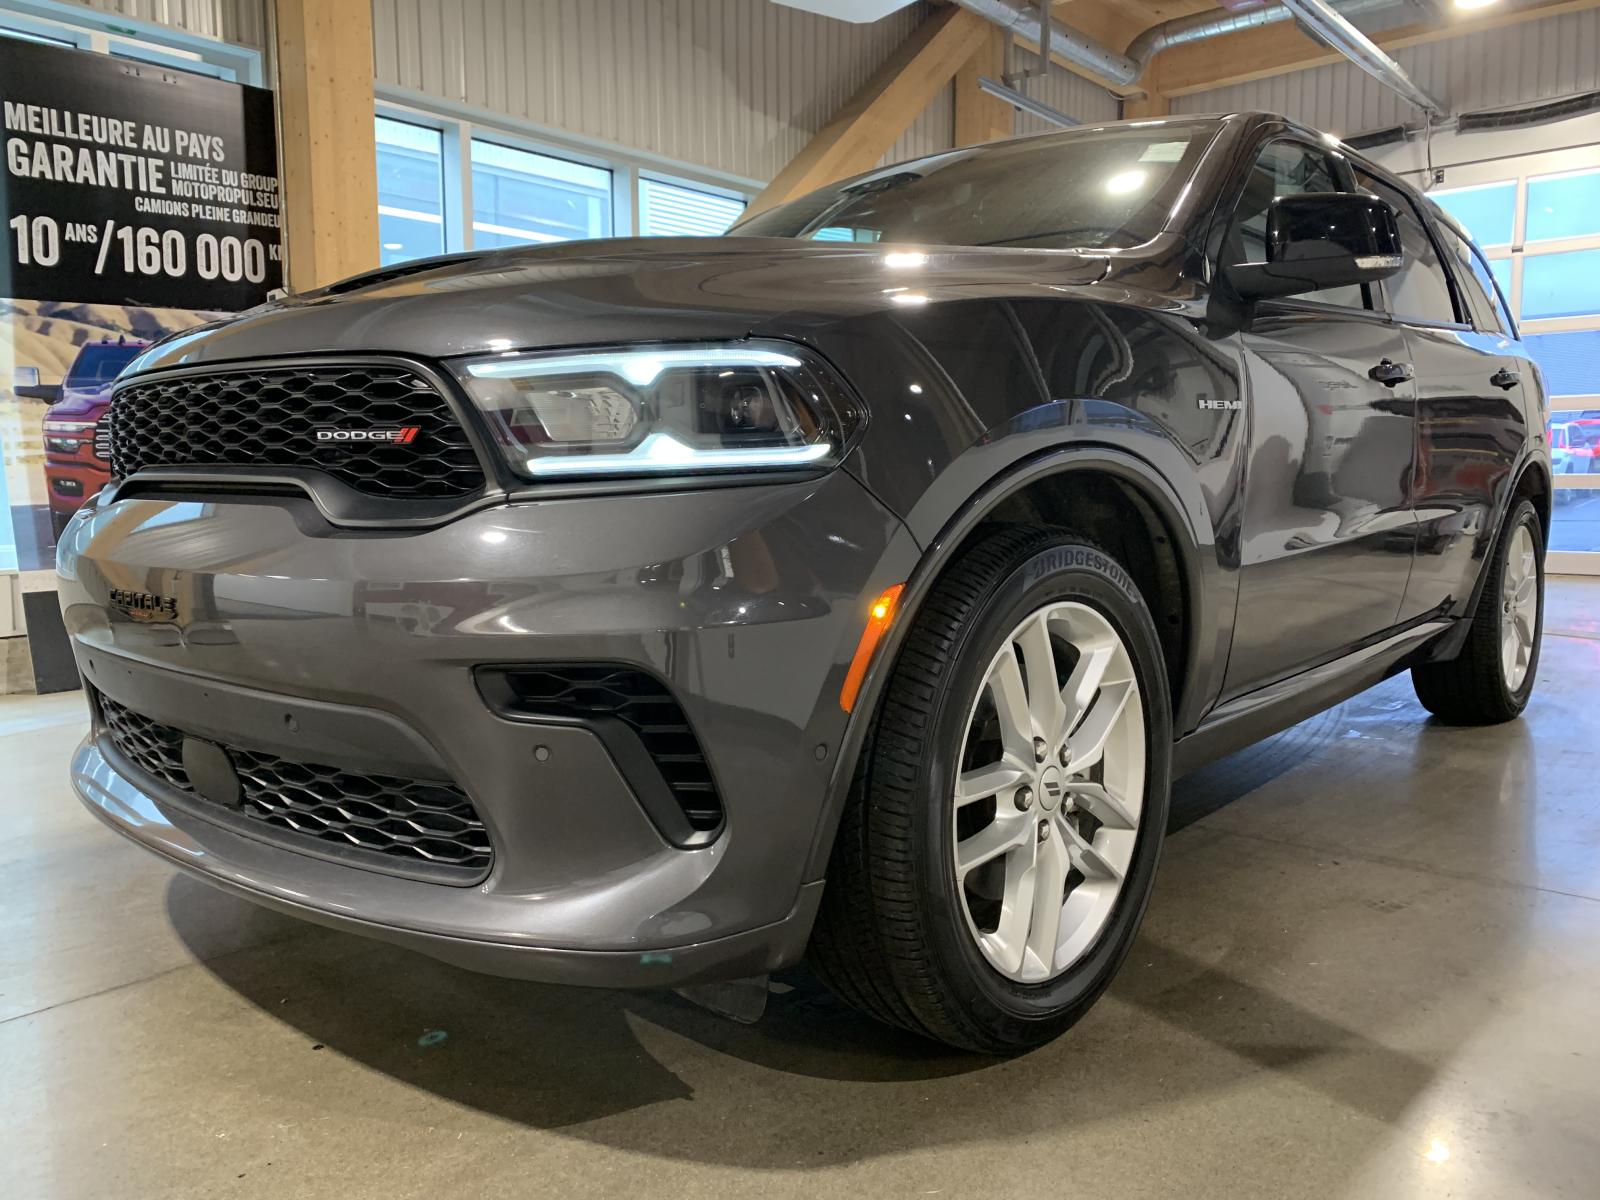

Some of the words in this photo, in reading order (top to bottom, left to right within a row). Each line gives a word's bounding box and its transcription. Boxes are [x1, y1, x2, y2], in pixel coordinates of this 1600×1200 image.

[4, 101, 138, 149] MEILLEURE
[142, 124, 170, 153] AU
[175, 130, 225, 162] PAYS
[7, 138, 166, 194] GARANTIE
[170, 161, 220, 184] LIMITÉE
[222, 170, 238, 187] DU
[134, 196, 190, 218] CAMIONS
[191, 203, 231, 222] PLEINE
[9, 214, 59, 267] 10
[64, 222, 98, 244] ANS
[196, 233, 266, 284] 000
[1199, 399, 1242, 410] HEMI
[316, 430, 404, 441] DODGE
[1032, 549, 1139, 603] BRIDGESTONE
